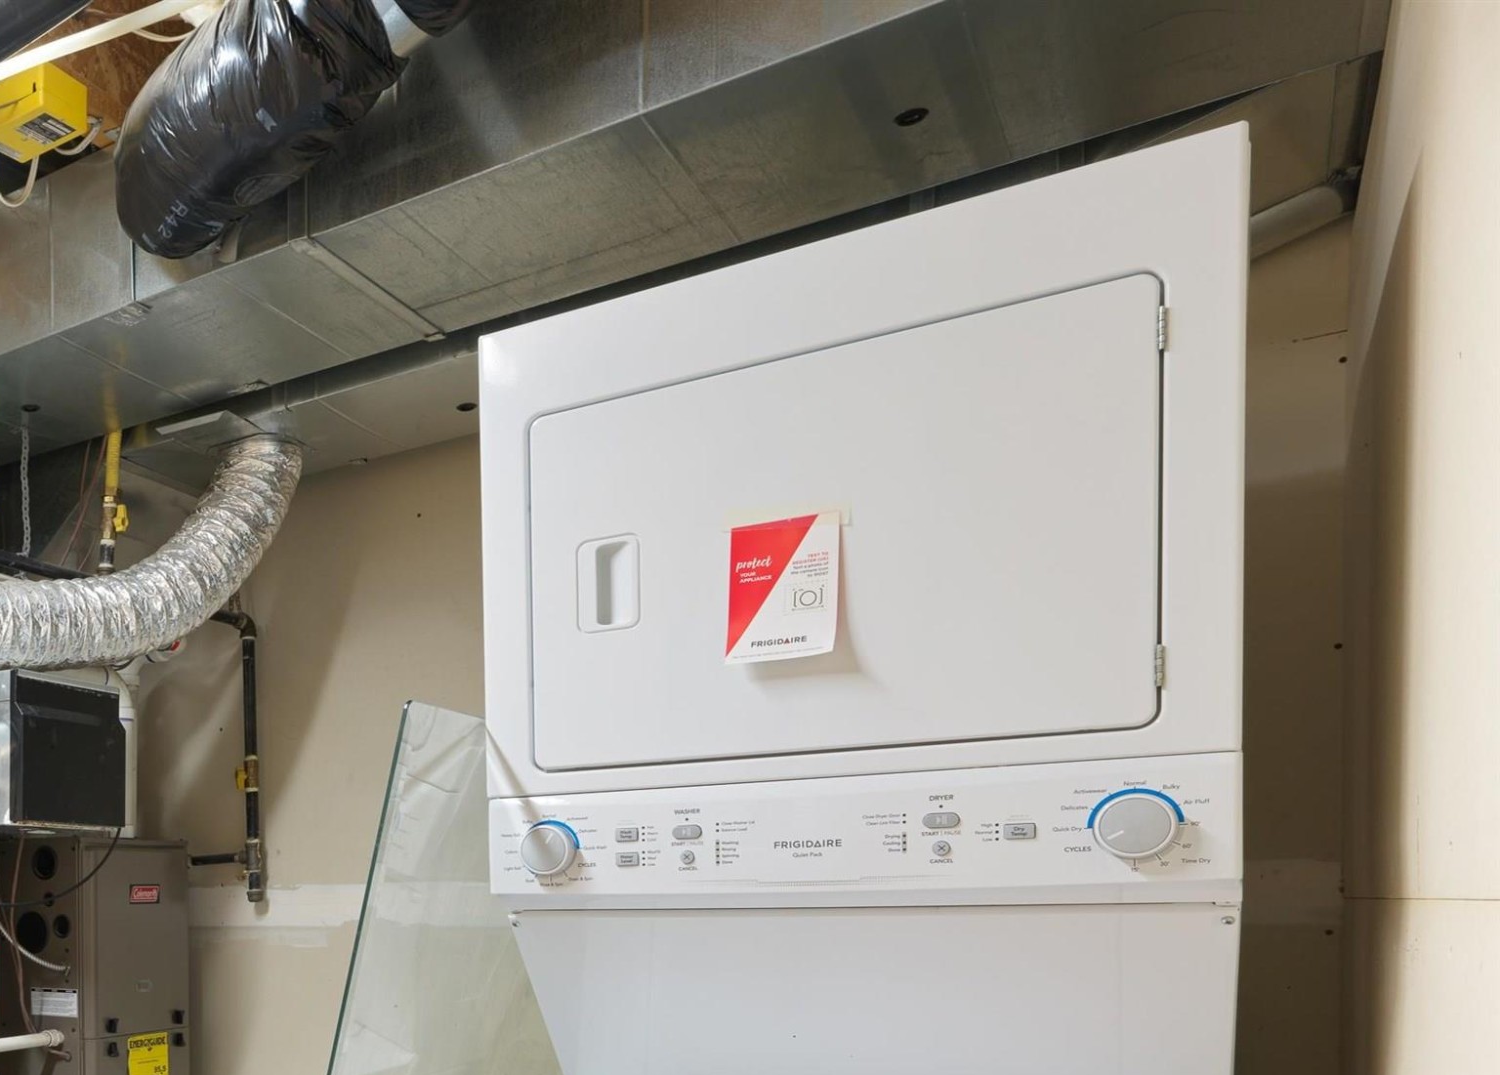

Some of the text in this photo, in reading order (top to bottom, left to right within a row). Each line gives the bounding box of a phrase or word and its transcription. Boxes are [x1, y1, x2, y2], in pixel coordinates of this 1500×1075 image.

[736, 555, 772, 573] protect
[739, 575, 772, 583] APPLIANCE
[751, 636, 807, 648] FRIGIDAIRE
[773, 839, 843, 849] FRIGIDAIRE
